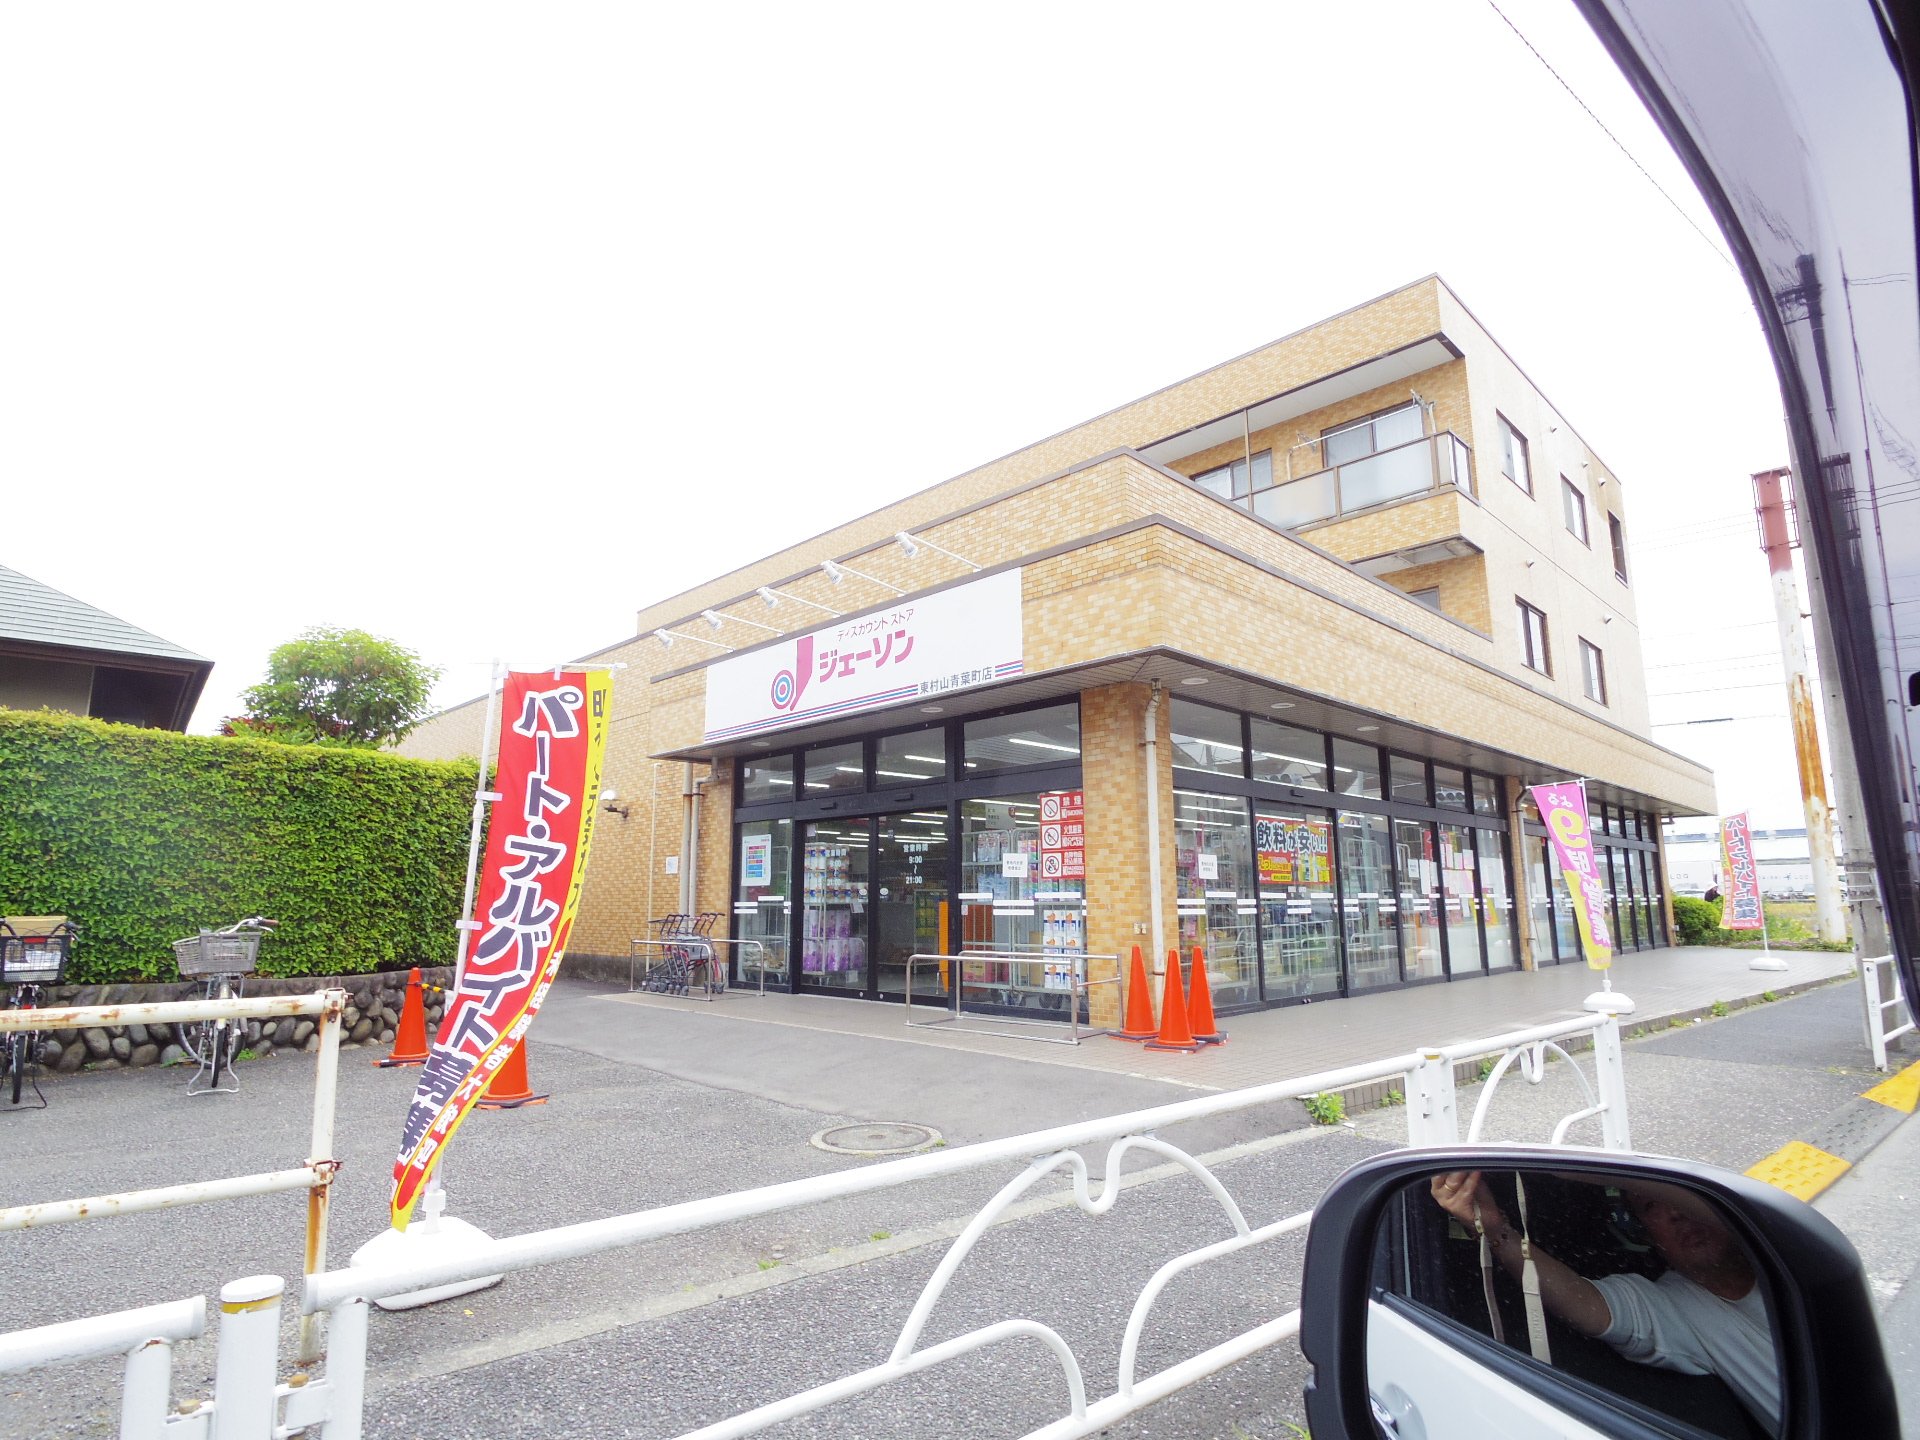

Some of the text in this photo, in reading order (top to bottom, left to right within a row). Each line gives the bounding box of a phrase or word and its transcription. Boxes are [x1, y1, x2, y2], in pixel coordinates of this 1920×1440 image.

[837, 607, 914, 642] ディスカウント ストア
[819, 629, 914, 683] ジェーソン
[919, 666, 993, 695] 東村山青葉町店
[903, 844, 929, 853] 営業時間
[908, 855, 923, 864] 9:00
[905, 875, 923, 885] 21:00
